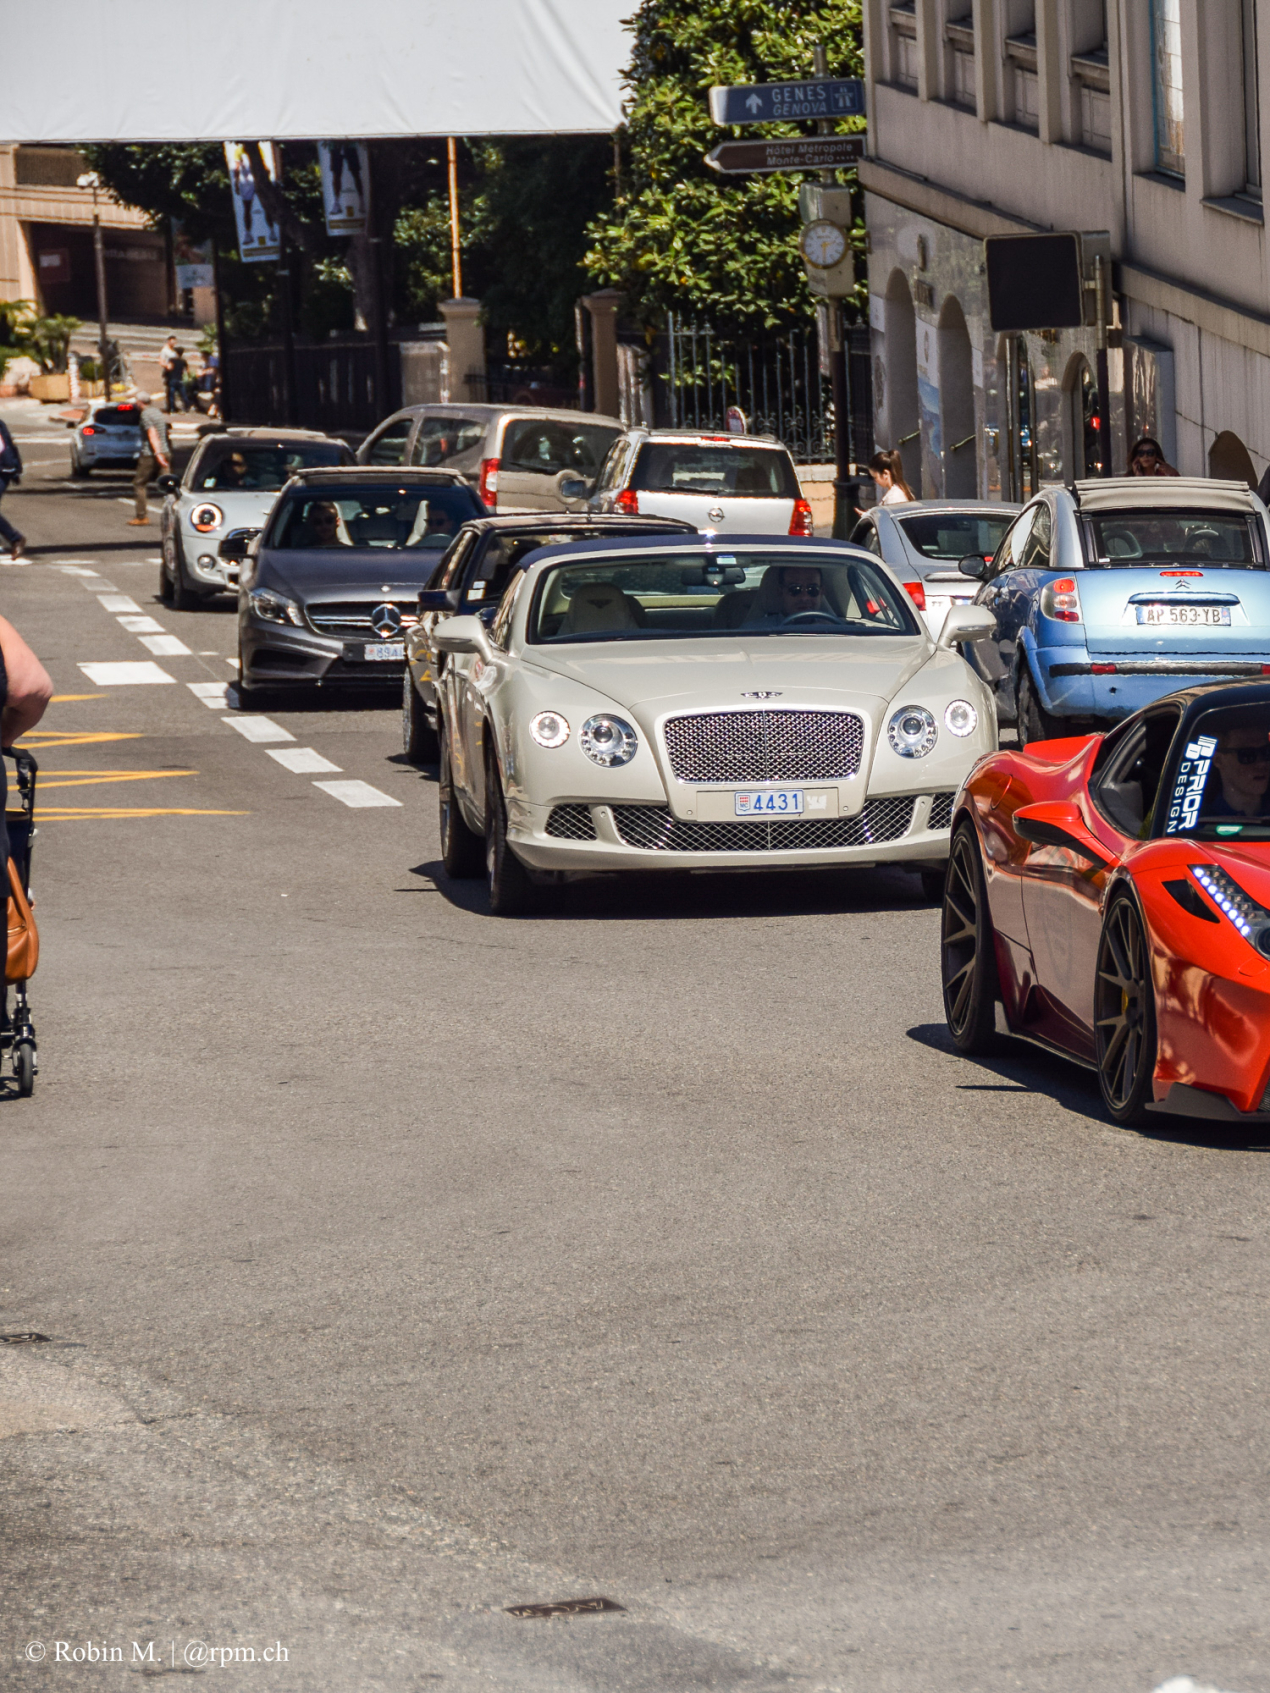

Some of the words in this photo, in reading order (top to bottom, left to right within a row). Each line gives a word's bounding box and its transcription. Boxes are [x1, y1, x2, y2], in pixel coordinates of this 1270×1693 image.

[772, 85, 826, 102] GENES
[773, 101, 827, 116] GENOVA
[766, 145, 795, 156] Hôtel
[799, 143, 853, 154] Métropole
[767, 154, 834, 166] Monte-Carlo
[753, 793, 798, 811] 4431
[1167, 762, 1191, 833] DESIGN
[1178, 759, 1211, 830] PRIOR
